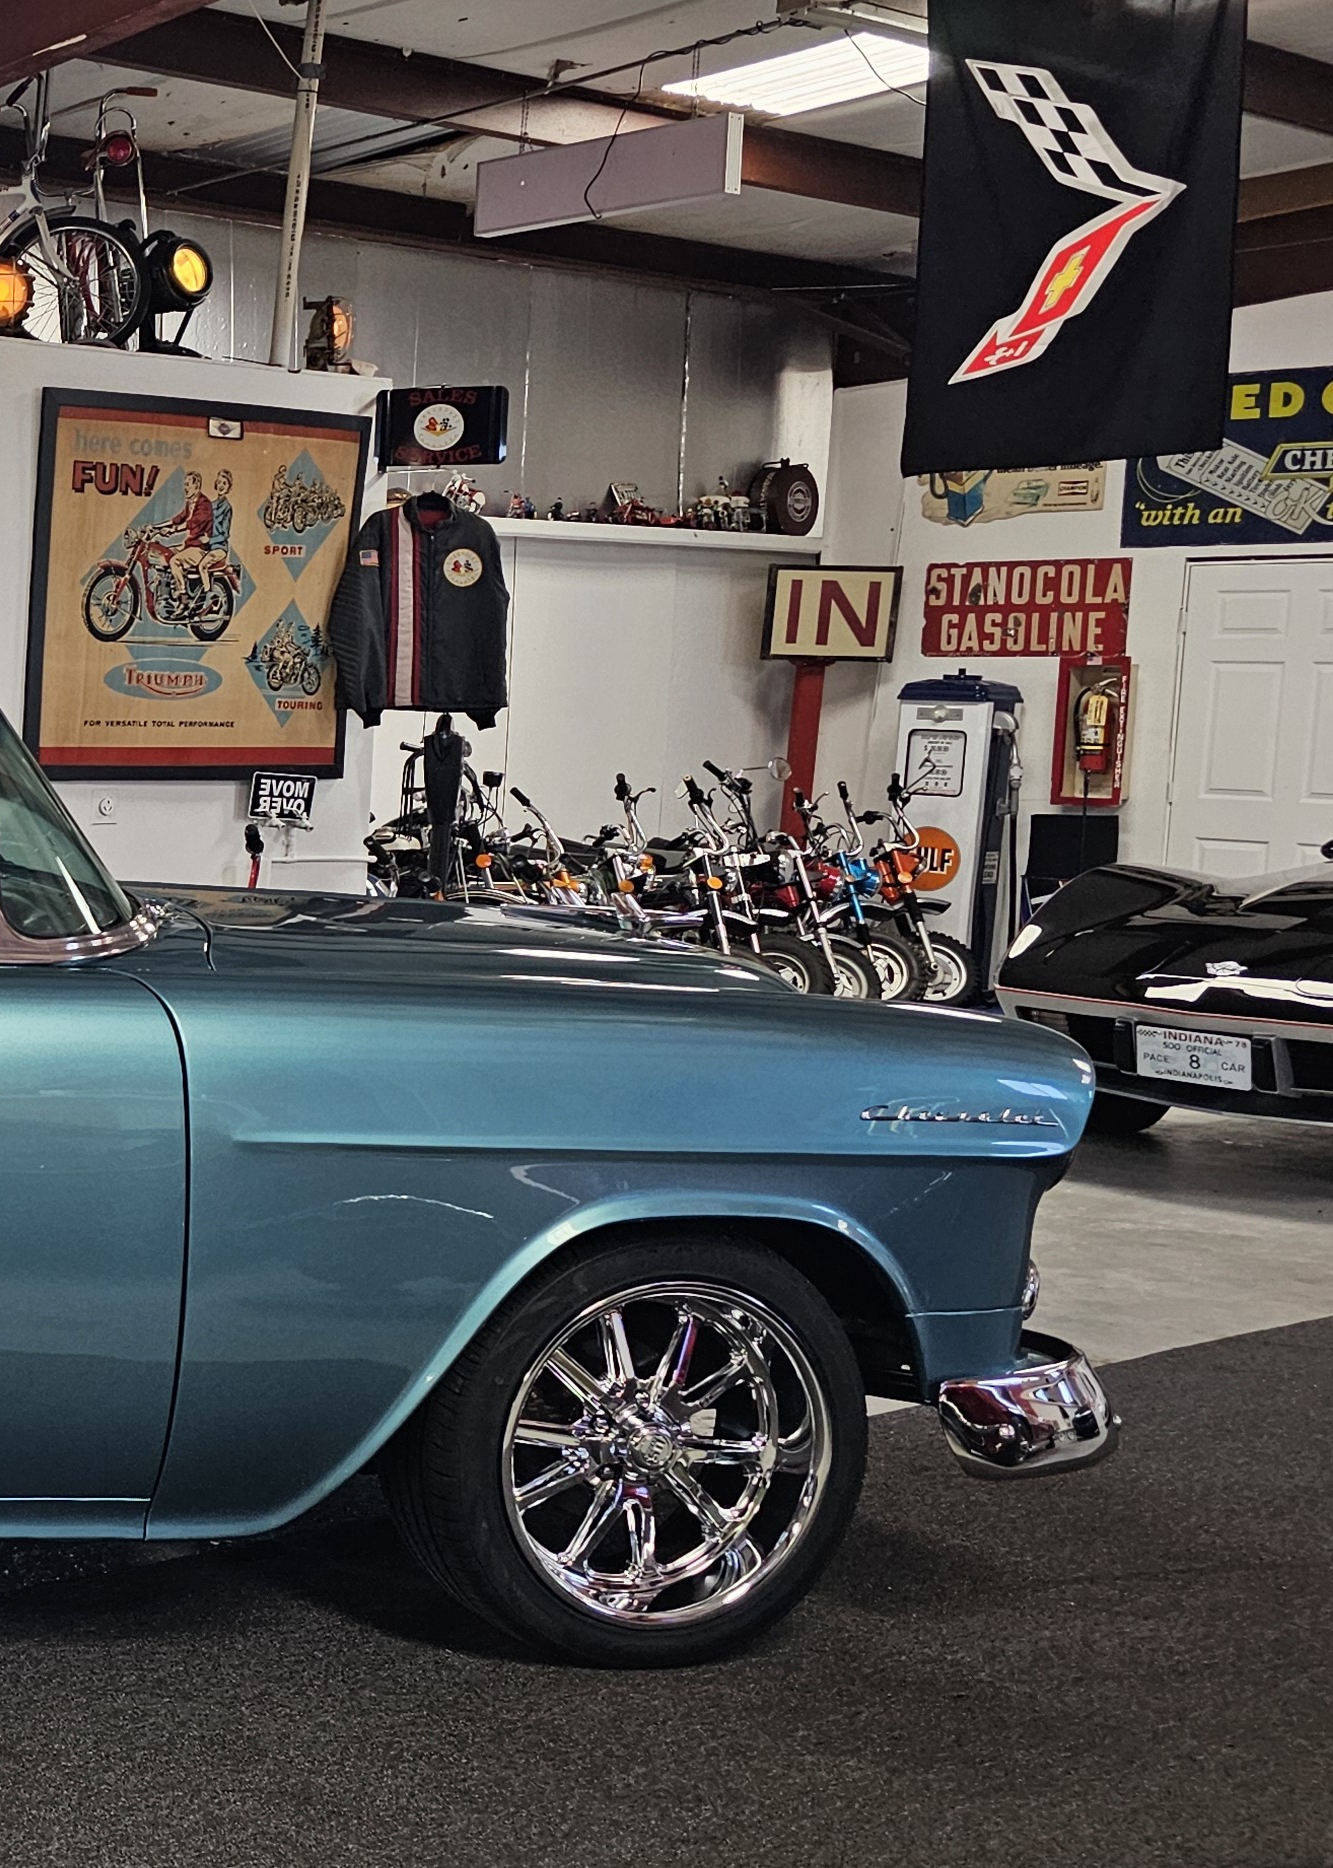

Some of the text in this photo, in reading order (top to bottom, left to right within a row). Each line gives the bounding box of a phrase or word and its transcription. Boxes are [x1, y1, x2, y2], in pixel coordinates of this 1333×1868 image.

[408, 389, 478, 406] SALES
[1230, 382, 1305, 420] ED
[74, 430, 193, 459] here comes
[394, 444, 482, 464] SRVICE
[72, 460, 160, 496] FUN!
[1207, 507, 1242, 523] an
[264, 545, 303, 557] SPORT
[928, 563, 1126, 606] STANOCOLA
[785, 579, 882, 648] IN
[940, 611, 1106, 652] GASOLINE
[125, 667, 207, 687] TRIUMPH
[277, 701, 323, 710] TOURING
[152, 720, 175, 728] TOTAL
[1113, 706, 1125, 788] EXTINGUISHER
[916, 847, 954, 874] ULF
[1163, 1031, 1224, 1046] INDIANA
[1162, 1042, 1222, 1057] 500 OFFICIAL
[1143, 1052, 1246, 1073] PACE 8 CAR
[1164, 1069, 1223, 1083] INDIANAPOLIS
